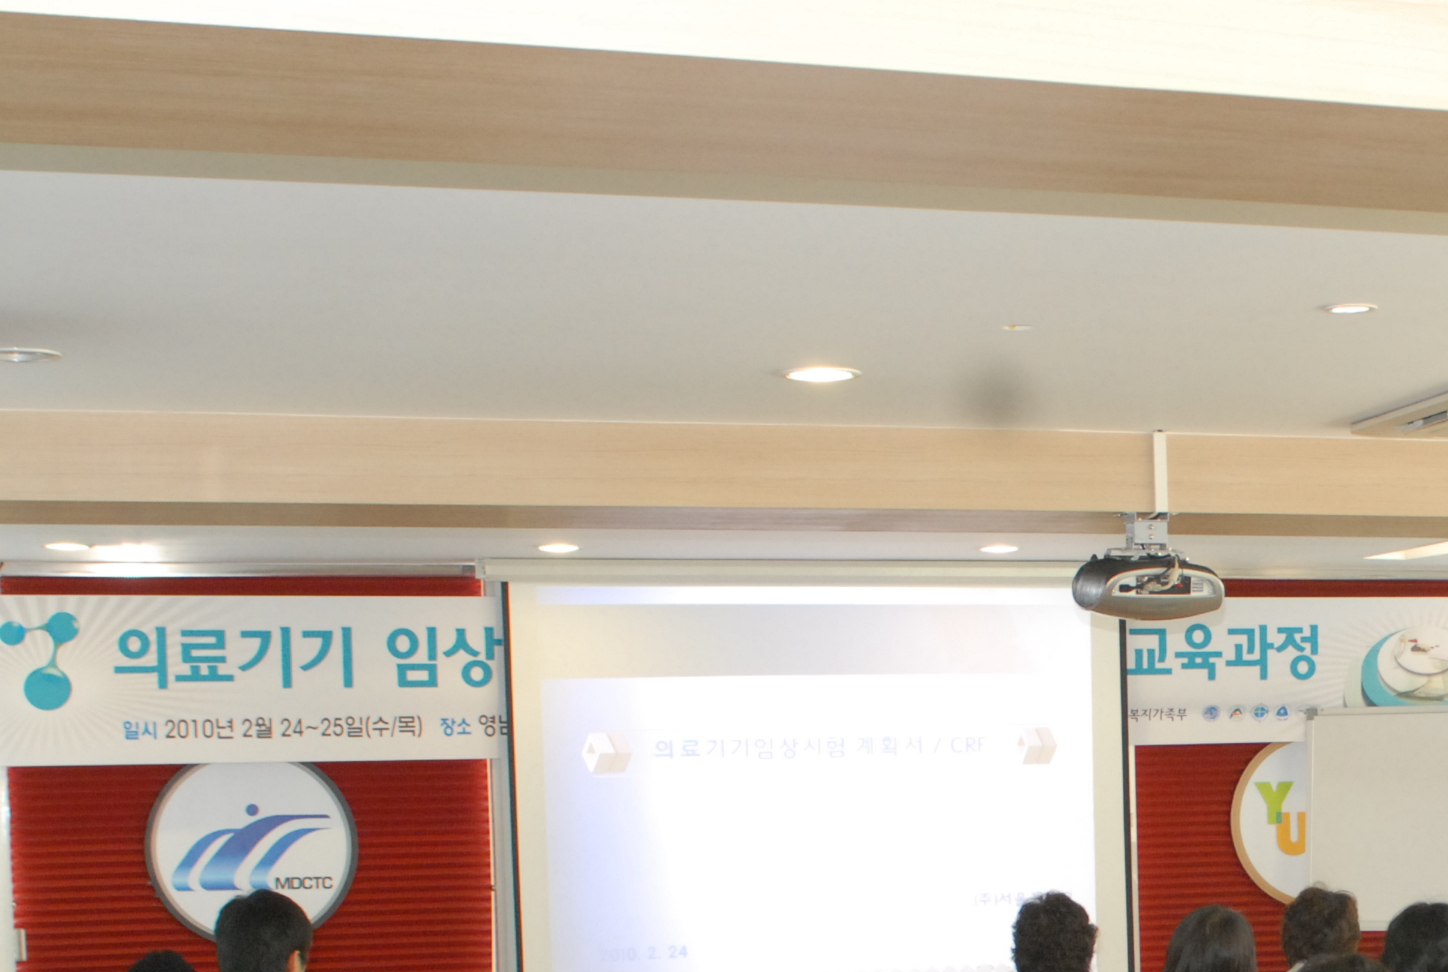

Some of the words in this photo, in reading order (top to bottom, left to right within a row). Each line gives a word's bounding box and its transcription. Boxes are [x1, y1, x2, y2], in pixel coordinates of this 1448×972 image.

[113, 626, 353, 689] 의료기기
[386, 626, 503, 688] 임상
[1127, 623, 1318, 680] 교육과정
[122, 720, 157, 740] 일시
[164, 718, 235, 739] 2010년
[242, 717, 273, 739] 2월
[280, 715, 423, 738] 24~25일(수/목)
[440, 718, 472, 737] 장소
[950, 736, 986, 753] CRF
[275, 876, 334, 889] MDCTC
[668, 945, 688, 959] 24
